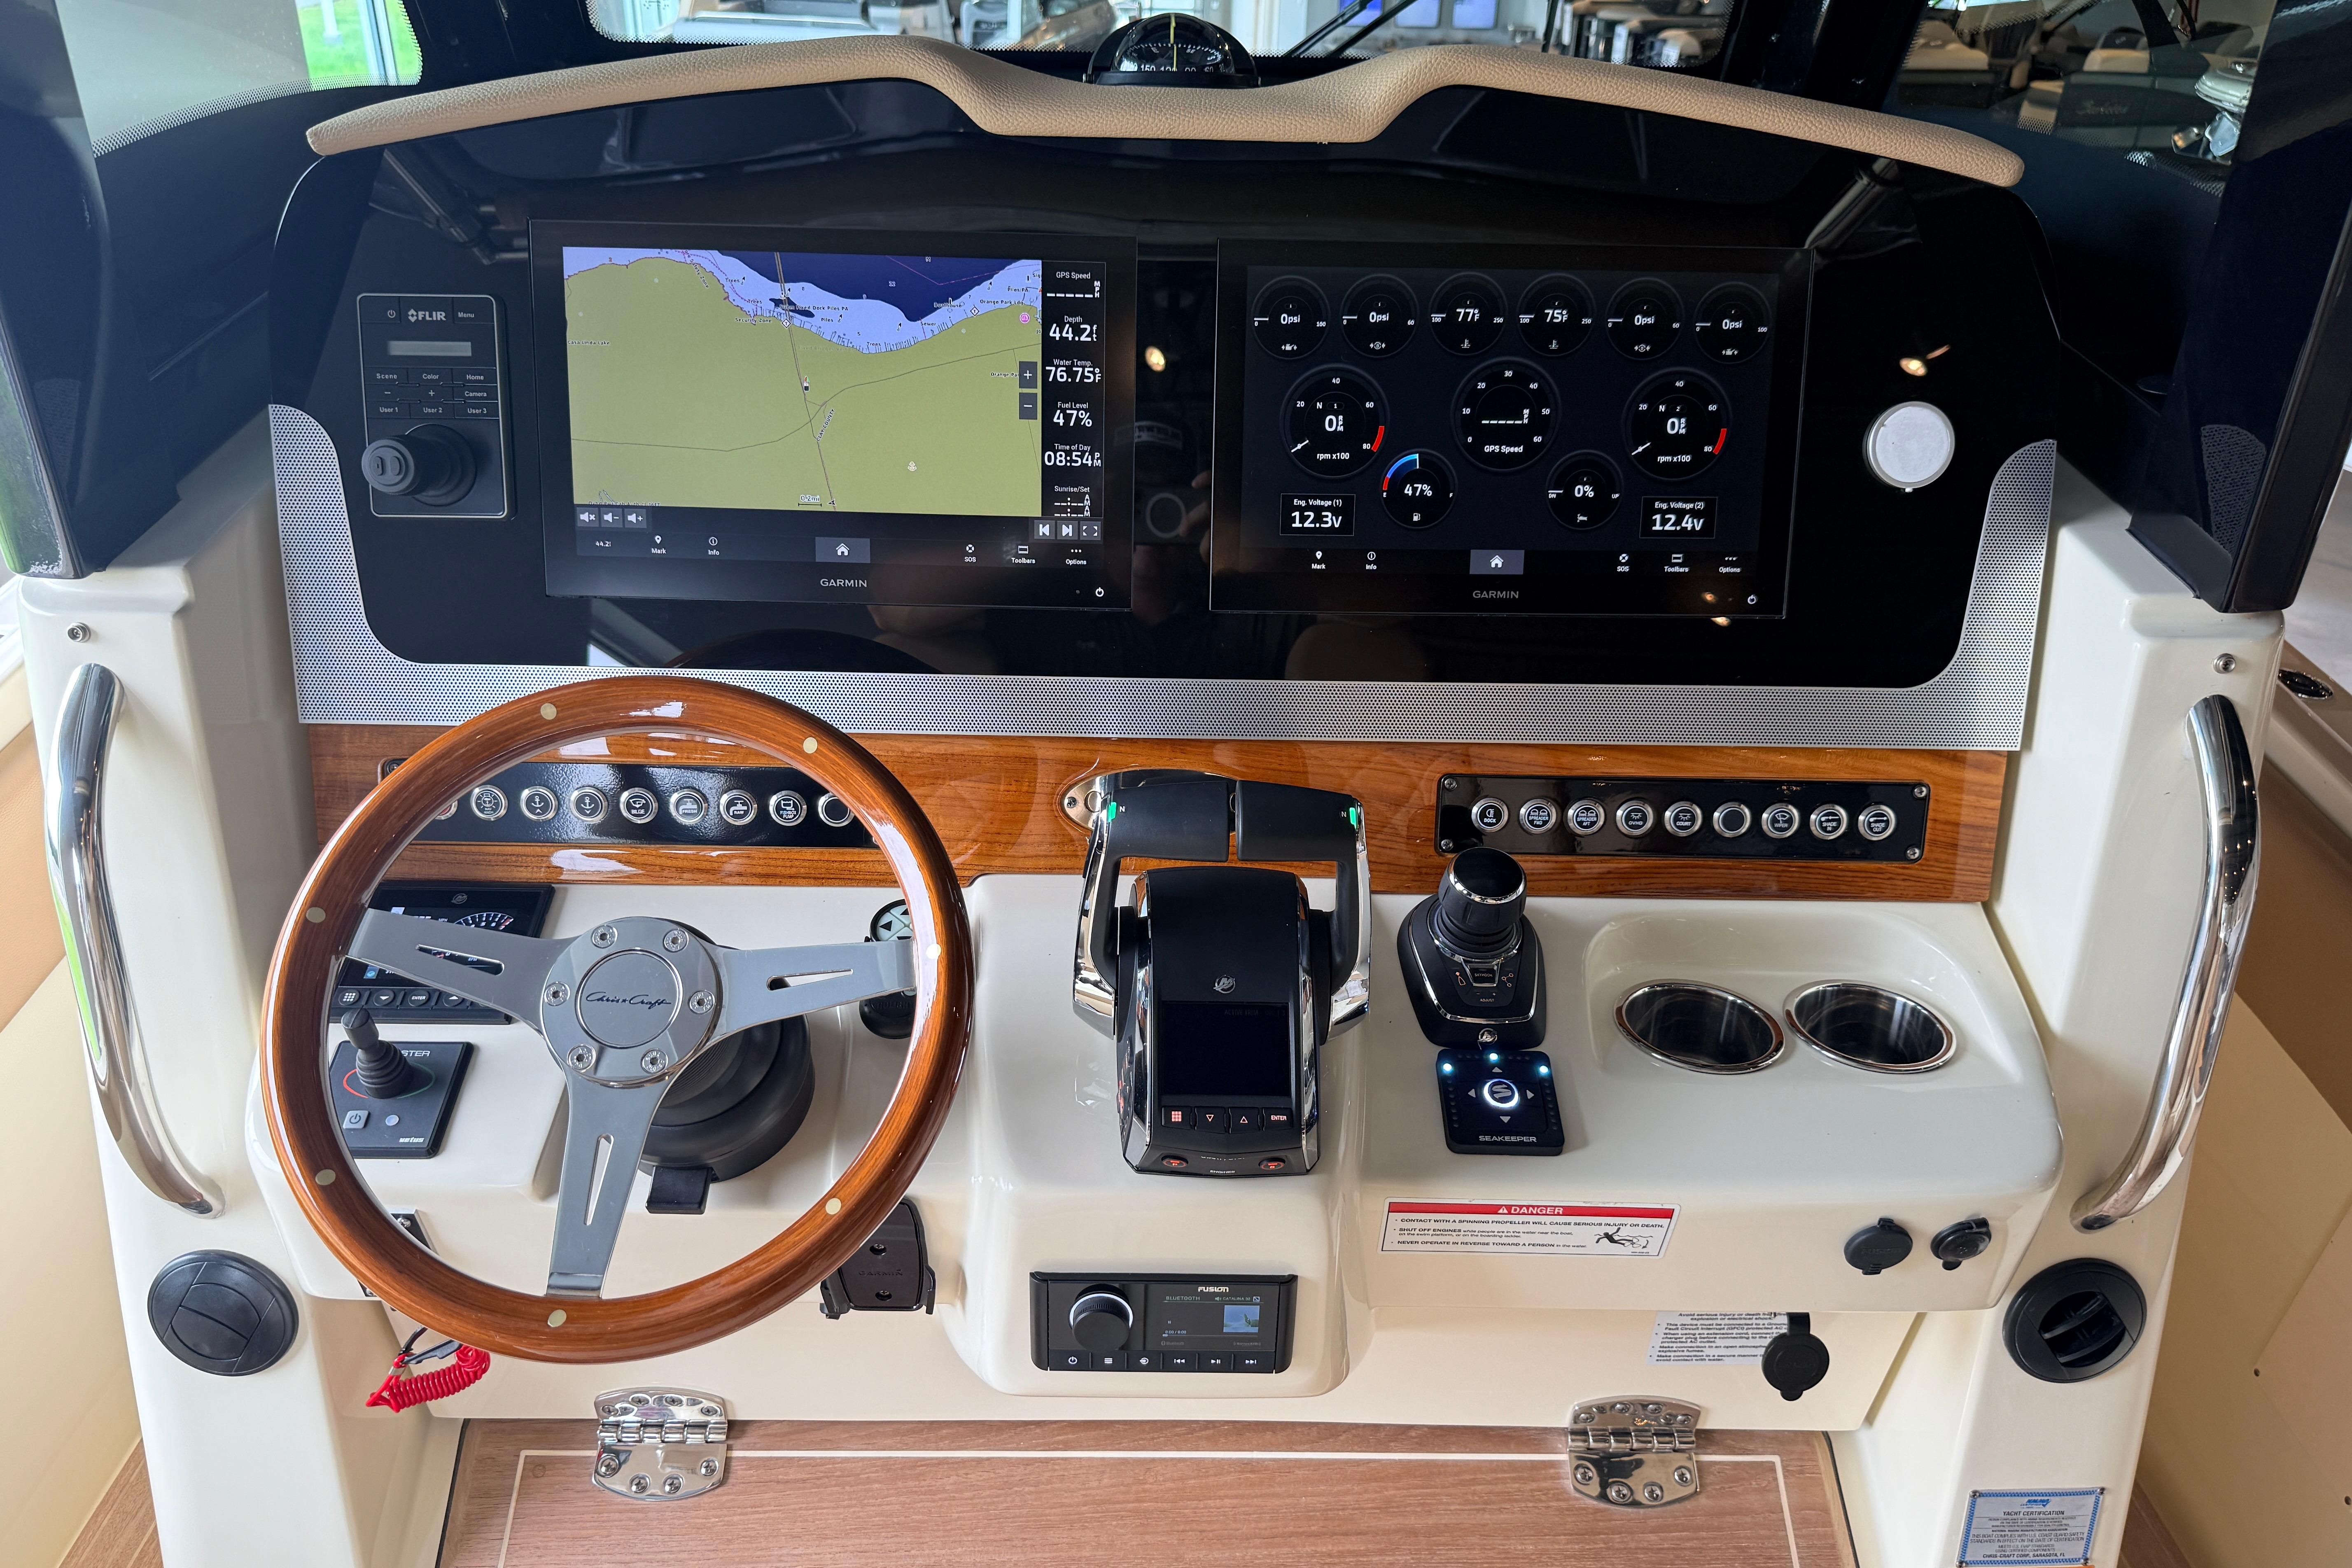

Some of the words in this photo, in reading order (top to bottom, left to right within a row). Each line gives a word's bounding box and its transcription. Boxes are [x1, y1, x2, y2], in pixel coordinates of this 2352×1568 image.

[1071, 272, 1091, 280] Speed
[418, 311, 446, 321] FLIR
[1064, 315, 1083, 324] Depth
[1281, 313, 1300, 325] 0psi
[1369, 312, 1389, 323] 0psi
[1635, 314, 1655, 325] 0psi
[1722, 319, 1743, 329] 0psi
[823, 408, 835, 429] COUNTY
[1053, 410, 1092, 427] 47%
[1501, 446, 1523, 454] Speed
[1044, 451, 1092, 467] 08:54
[1094, 452, 1101, 467] PM
[1404, 484, 1433, 497] 47%
[1575, 485, 1594, 497] 0%
[1695, 502, 1704, 510] (2)
[820, 578, 867, 588] GARMIN
[1473, 590, 1519, 599] GARMIN
[1511, 1206, 1563, 1214] DANGER
